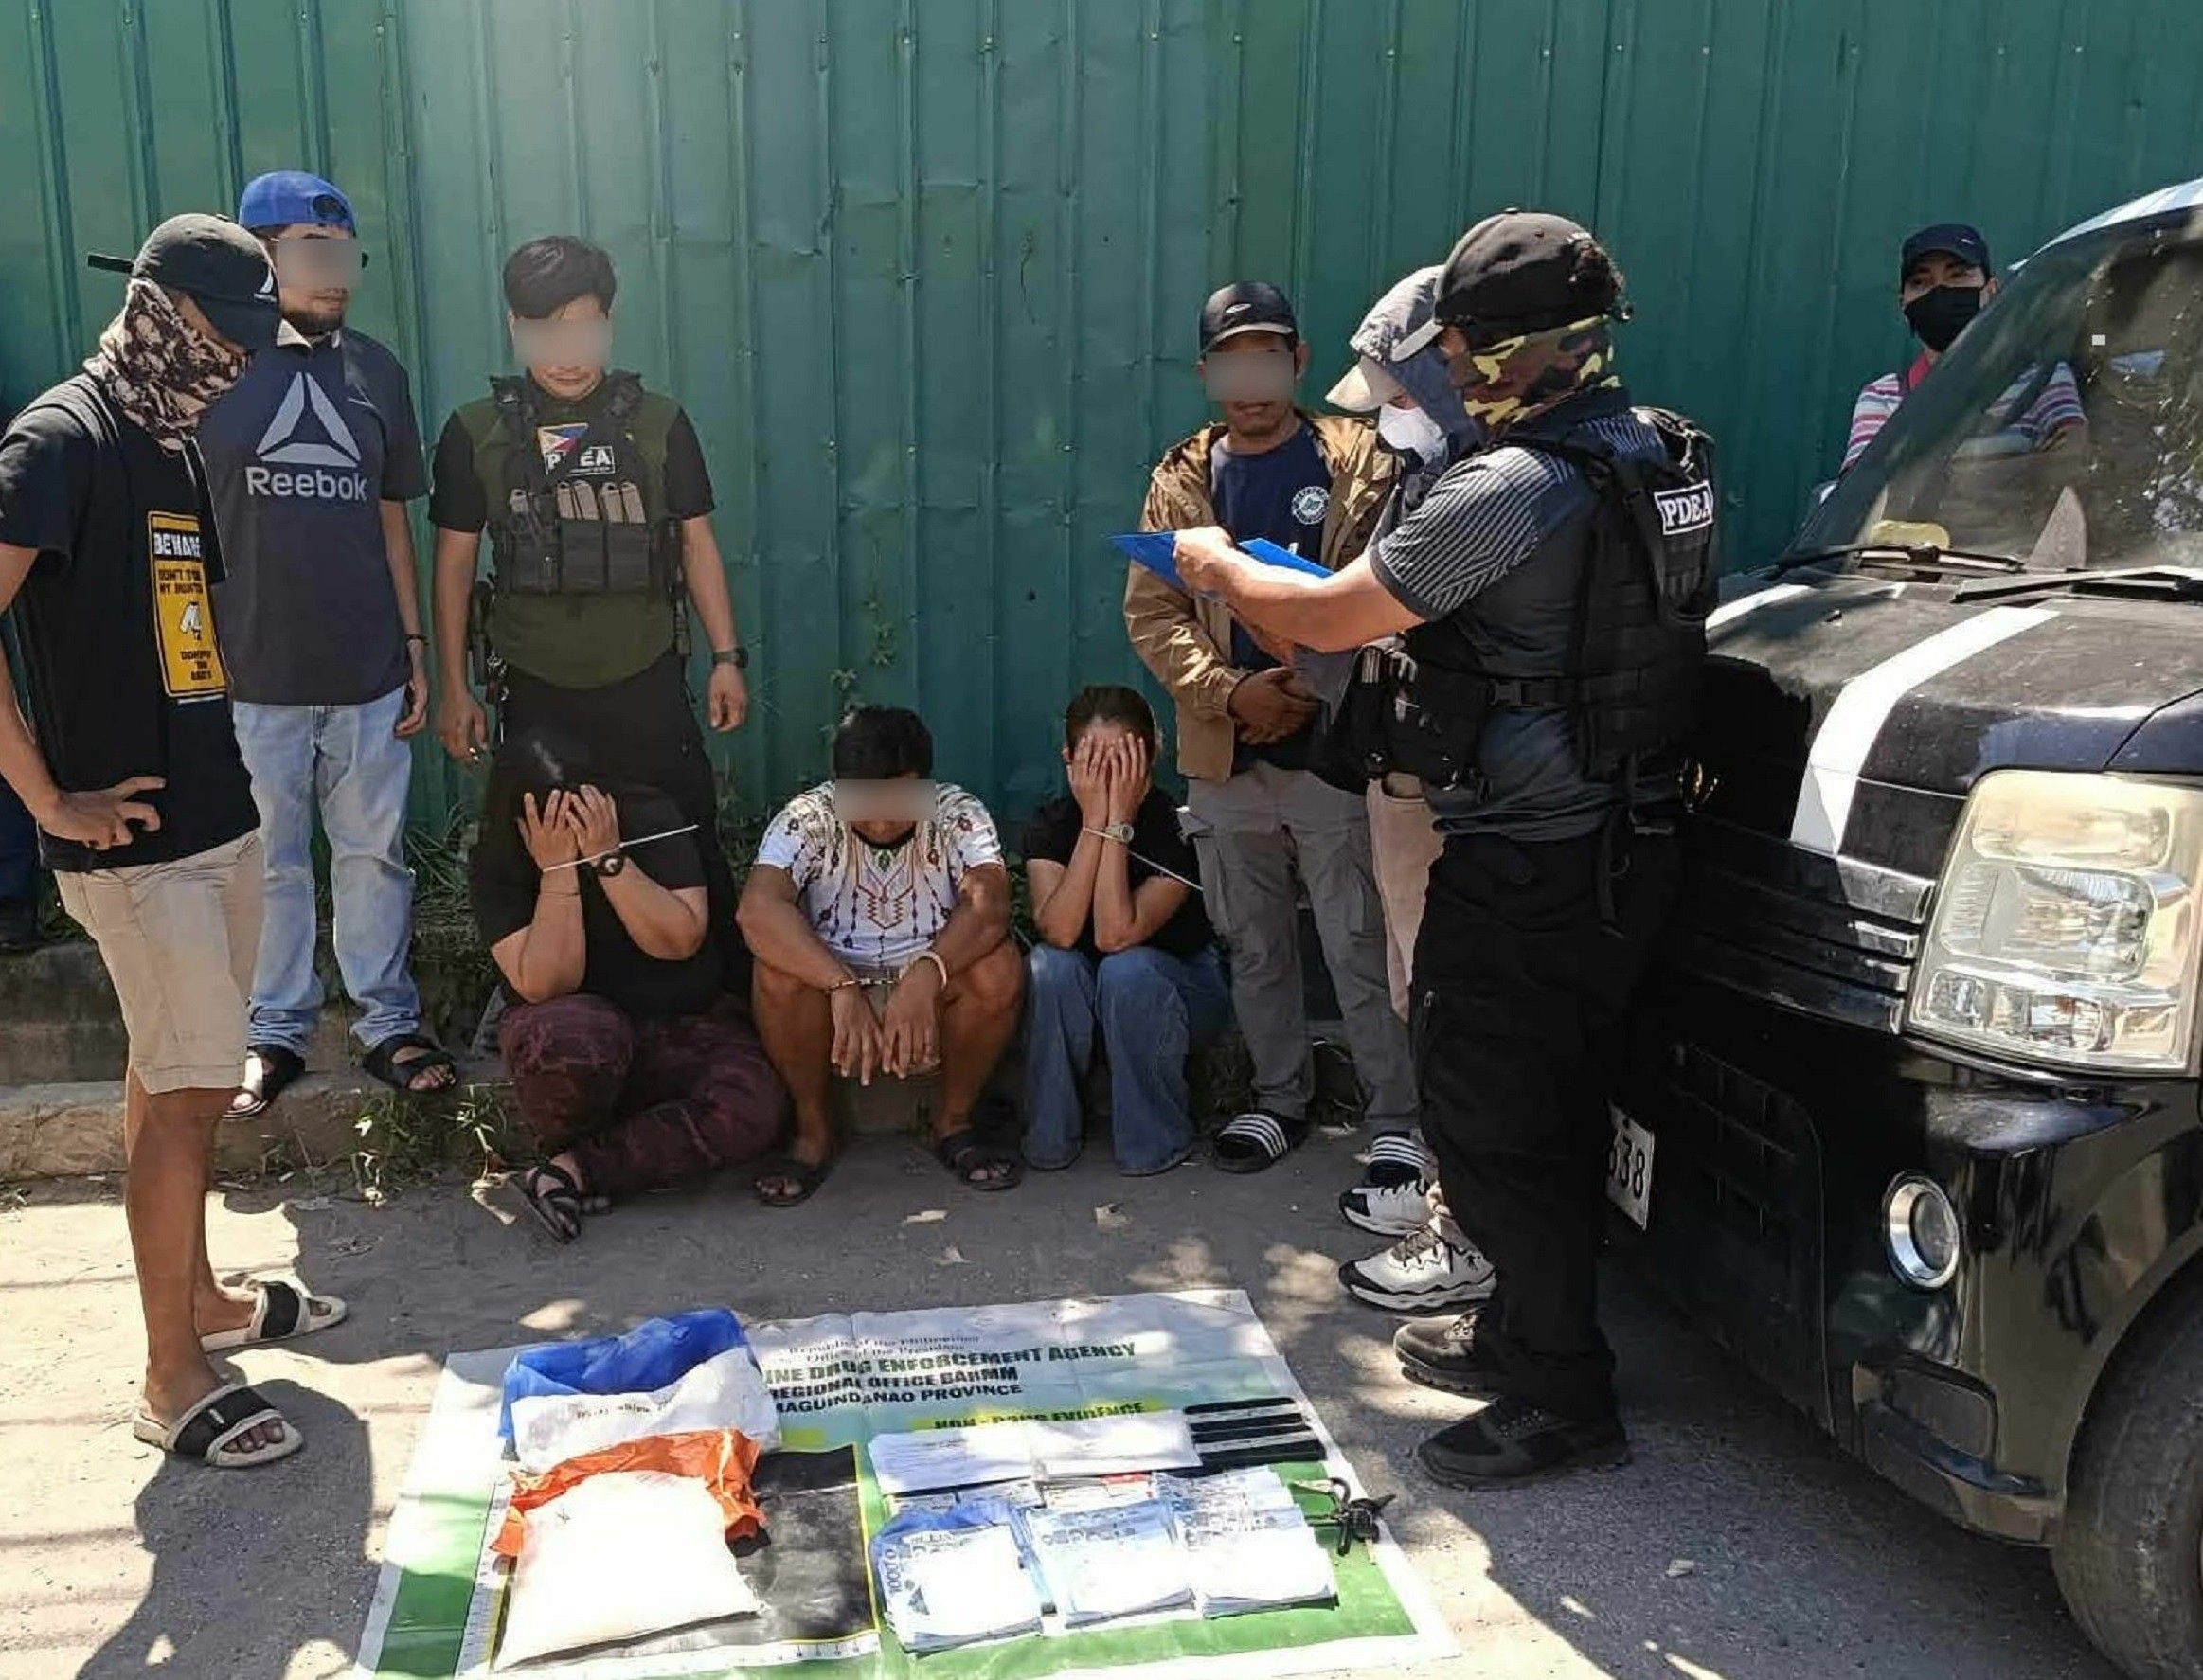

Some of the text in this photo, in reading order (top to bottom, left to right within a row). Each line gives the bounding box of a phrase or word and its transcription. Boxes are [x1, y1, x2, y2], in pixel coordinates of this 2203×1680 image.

[546, 449, 611, 470] PEA
[244, 465, 368, 501] Reebok
[764, 1342, 1136, 1385] INE DRUG ENFORCEMENT AGENCY
[921, 1384, 1023, 1402] PROVINCE
